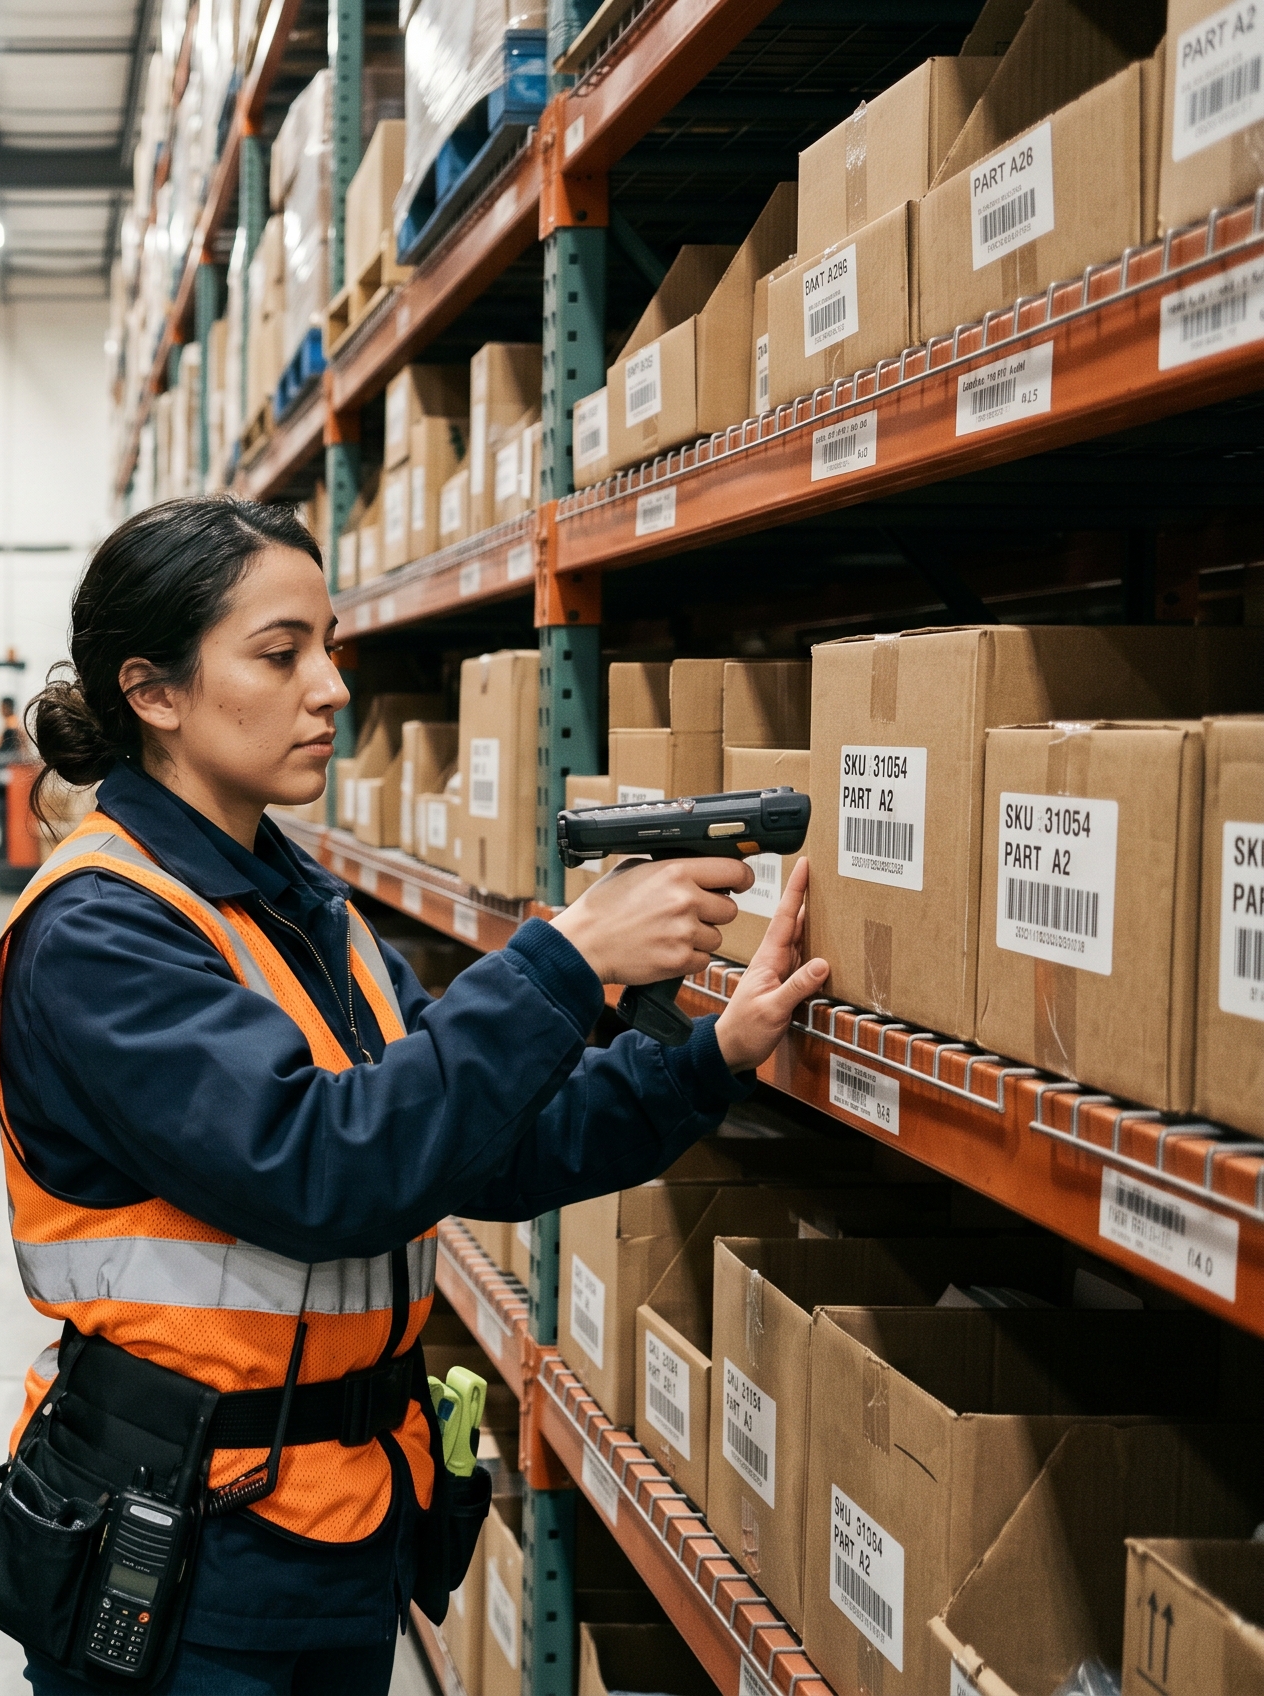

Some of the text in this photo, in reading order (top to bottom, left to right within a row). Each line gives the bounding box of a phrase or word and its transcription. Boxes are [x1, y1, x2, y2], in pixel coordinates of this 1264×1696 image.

[1182, 19, 1228, 69] PART
[974, 162, 1006, 198] PART
[844, 753, 908, 779] SKU 31054
[843, 786, 894, 813] PART A2
[1005, 803, 1091, 839] SKU 31054
[1004, 841, 1071, 877] PART A2
[834, 1524, 870, 1577] PART A2
